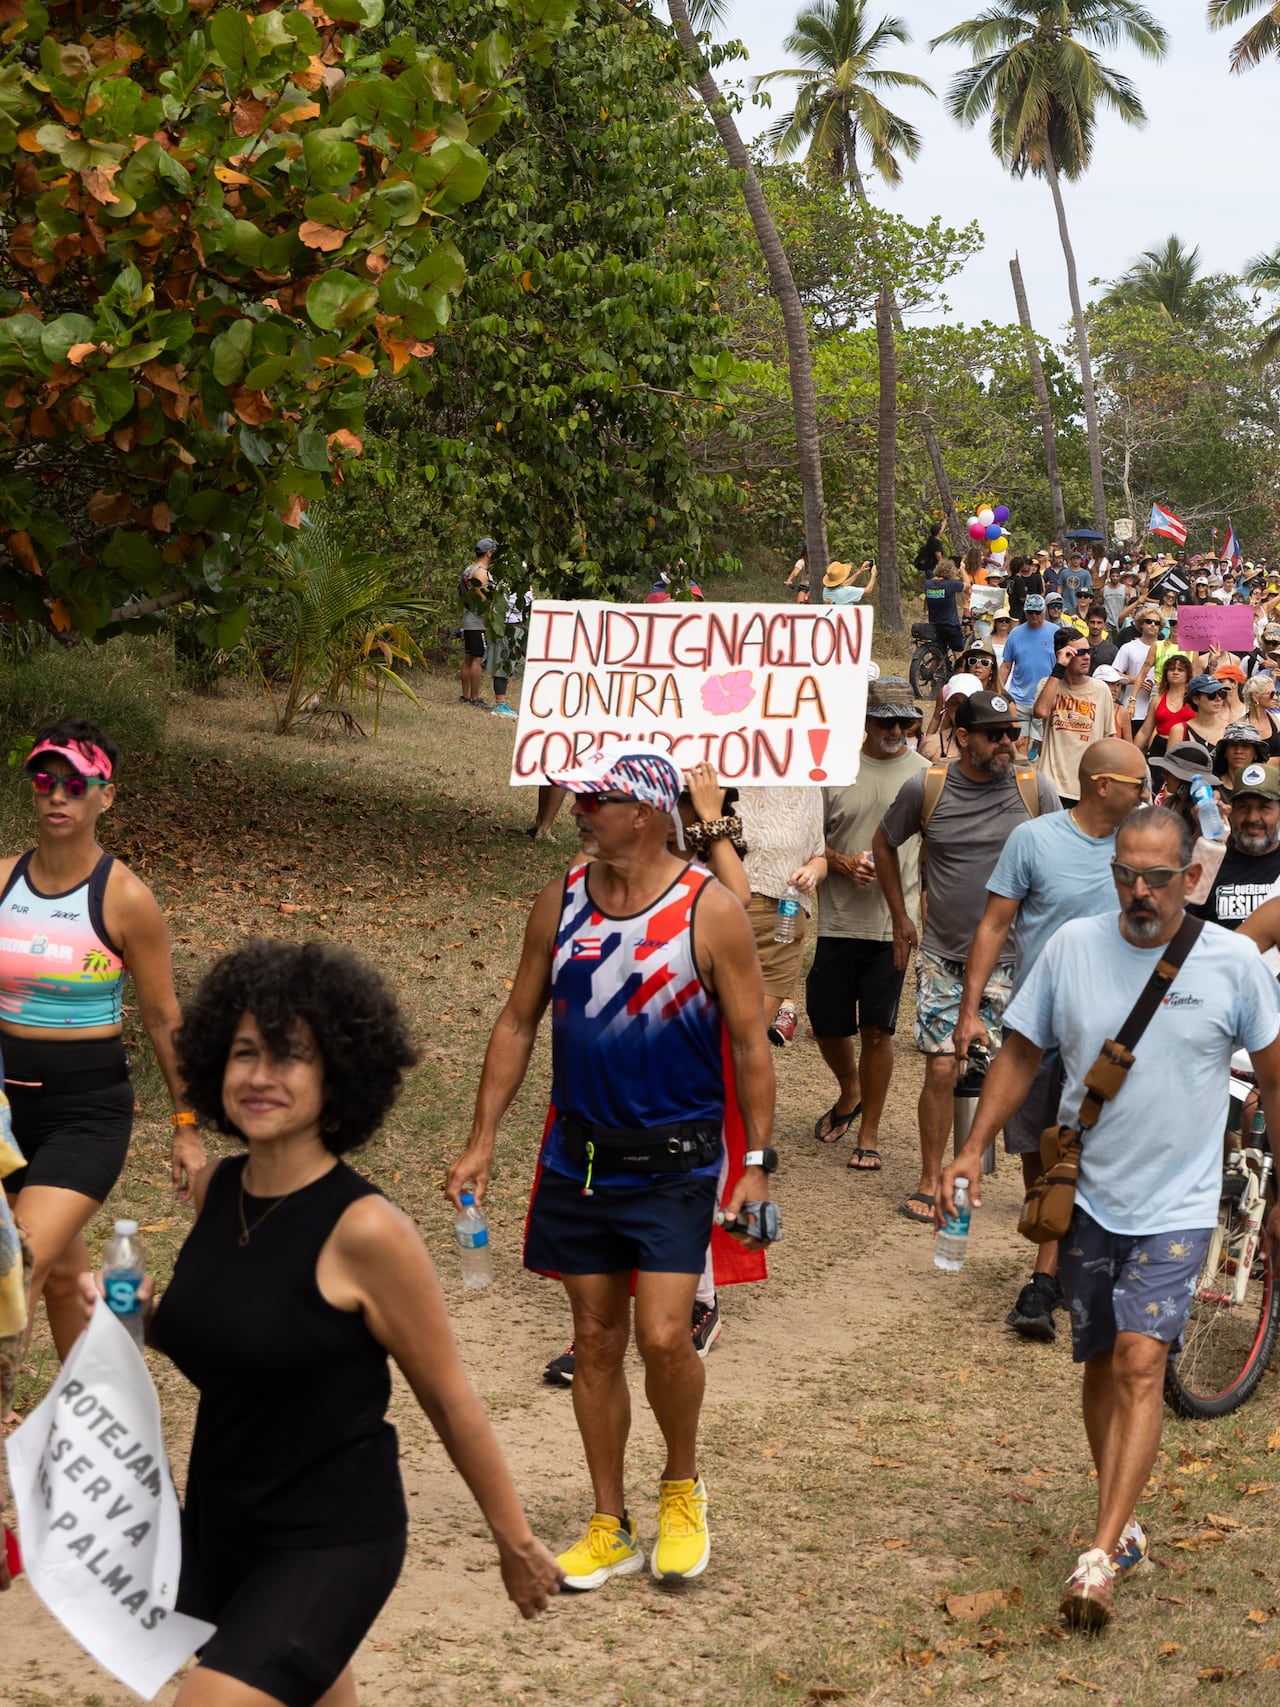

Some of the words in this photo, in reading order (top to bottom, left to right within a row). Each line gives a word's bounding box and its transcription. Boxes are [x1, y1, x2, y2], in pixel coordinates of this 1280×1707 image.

[527, 606, 863, 672] INDIGNACIÓN
[529, 669, 685, 719] CONTRA
[761, 672, 828, 723] LA
[1218, 894, 1266, 917] DESLI
[1235, 882, 1273, 896] QUEREMO
[60, 1379, 162, 1497] ROTEJAM
[51, 1436, 153, 1549] SERVA
[50, 1510, 168, 1631] PALMAS
